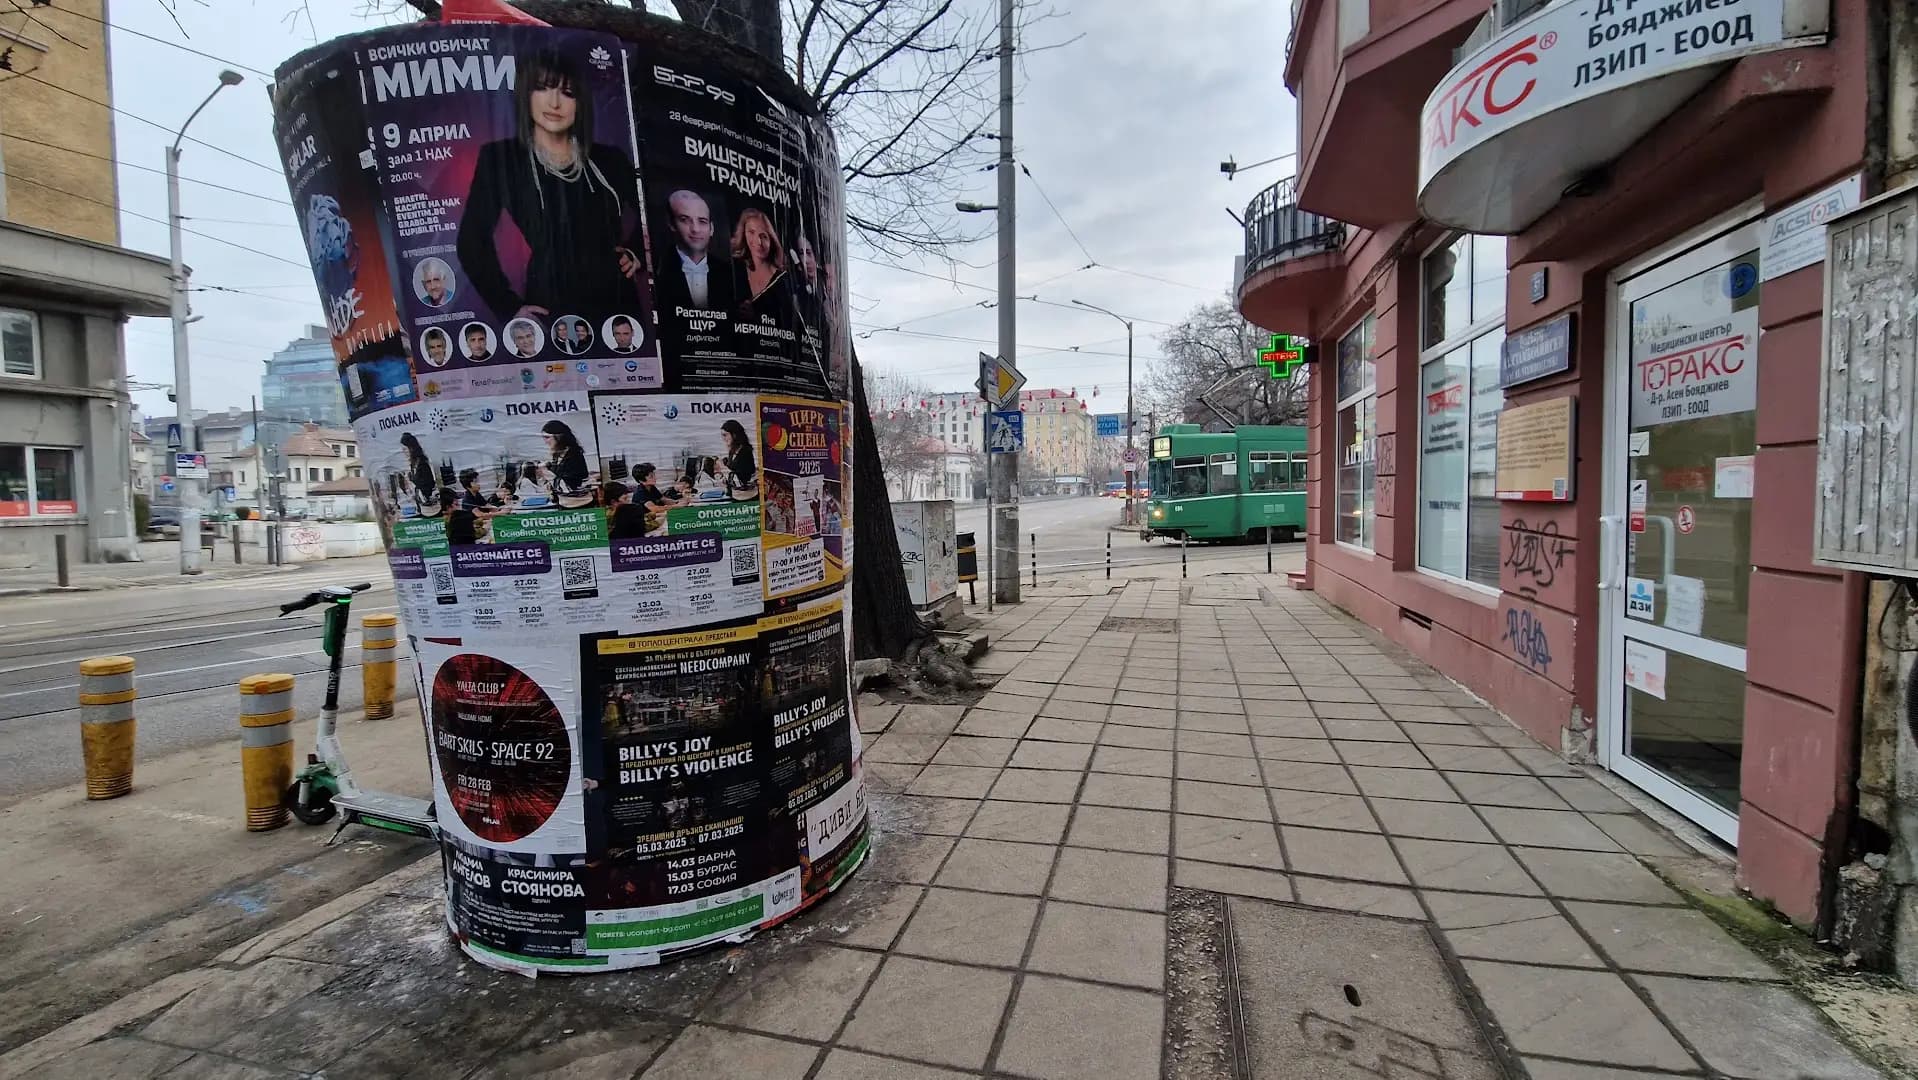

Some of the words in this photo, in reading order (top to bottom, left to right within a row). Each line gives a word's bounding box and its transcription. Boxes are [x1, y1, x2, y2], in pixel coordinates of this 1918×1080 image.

[368, 43, 427, 62] ВСИЧКИ
[430, 38, 490, 54] ОБИЧАТ
[1574, 42, 1646, 88] ЛЗИП
[1674, 14, 1754, 55] ЕООД
[373, 55, 517, 103] МИМИ
[1425, 34, 1538, 158] АКС
[383, 123, 400, 148] 9
[408, 123, 471, 144] АПРИЛ
[388, 153, 413, 169] Зала
[415, 150, 422, 161] 1
[425, 146, 453, 161] НДК
[684, 136, 800, 192] ВИШЕГРАДСКИ
[390, 172, 413, 183] 20.00
[706, 162, 791, 208] ТРАДИЦИИ
[394, 193, 428, 204] БИЛЕТИ:
[395, 201, 426, 212] КАСИТЕ
[428, 200, 440, 208] НА
[442, 198, 460, 207] НДК
[675, 306, 727, 320] Растислав
[761, 314, 776, 326] Яна
[689, 320, 716, 333] ЩУР
[734, 323, 796, 341] ИБРИШИМОВА
[1651, 334, 1697, 354] Медицински
[1699, 322, 1732, 341] център
[1637, 335, 1745, 392] ТОРАКС
[1666, 387, 1684, 400] Асен
[1686, 379, 1729, 398] Бояджиев
[505, 399, 579, 416] ПОКАНА
[690, 402, 752, 414] ПОКАНА
[1688, 399, 1709, 415] ЕООД
[378, 410, 421, 431] ПОКАНА
[789, 409, 824, 428] ЦИРК
[789, 432, 826, 450] СЦЕНА
[798, 460, 821, 474] 2025
[521, 512, 596, 528] ОПОЗНАЙТЕ
[698, 505, 760, 519] ОПОЗНАЙТЕ
[500, 530, 536, 538] Основно
[674, 521, 711, 530] Основно
[456, 549, 524, 561] ЗАПОЗНАЙТЕ
[526, 548, 542, 558] СЕ
[618, 540, 699, 556] ЗАПОЗНАЙТЕ
[701, 539, 716, 548] СЕ
[687, 567, 710, 575] 27.02
[690, 593, 713, 601] 27.03
[1630, 600, 1651, 613] ДЗИ
[638, 636, 704, 648] ТОПЛОЦЕНТРАЛА
[680, 652, 751, 674] NEEDCOMPANY
[456, 680, 477, 693] YALTA
[477, 682, 499, 694] CLUB
[773, 703, 809, 728] BILLY'S
[810, 695, 826, 712] JOY
[774, 722, 810, 749] BILLY'S
[811, 705, 845, 732] VIOLENCE
[439, 731, 457, 751] BART
[457, 737, 484, 757] SKILS
[491, 742, 532, 760] SPACE
[535, 743, 554, 760] 92
[619, 742, 678, 762] BILLY'S
[682, 736, 711, 754] JOY
[620, 764, 680, 785] BILLY'S
[684, 749, 753, 776] VIOLENCE
[637, 837, 687, 854] 05.03.2025
[698, 823, 744, 843] 07.03.2025
[667, 858, 695, 869] 14.03
[697, 849, 736, 864] ВАРНА
[452, 859, 491, 888] АНГЕЛОВ
[507, 868, 574, 881] КРАСИМИРА
[667, 870, 695, 882] 15.03
[697, 860, 737, 877] БУРГАС
[501, 880, 585, 897] СТОЯНОВА
[668, 882, 695, 895] 17.03
[696, 872, 737, 889] СОФИЯ
